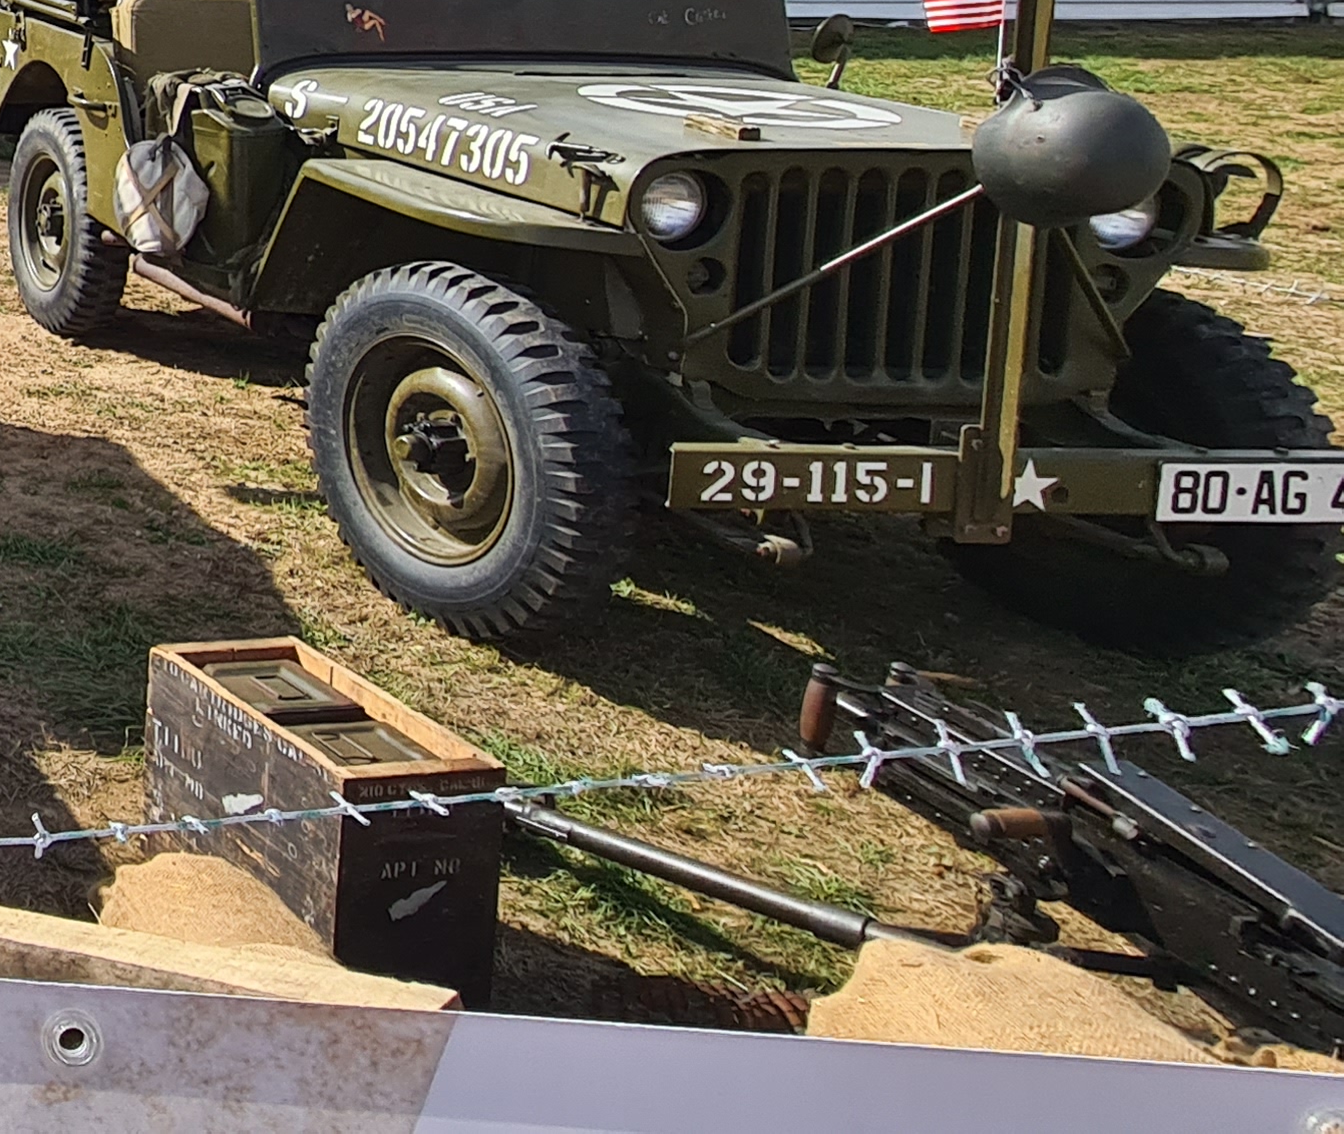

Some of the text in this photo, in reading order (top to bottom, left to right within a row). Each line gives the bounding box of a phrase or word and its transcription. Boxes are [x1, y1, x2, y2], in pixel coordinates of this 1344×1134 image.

[438, 92, 538, 117] USA
[357, 98, 541, 186] 20547305
[195, 696, 253, 750] LINKED
